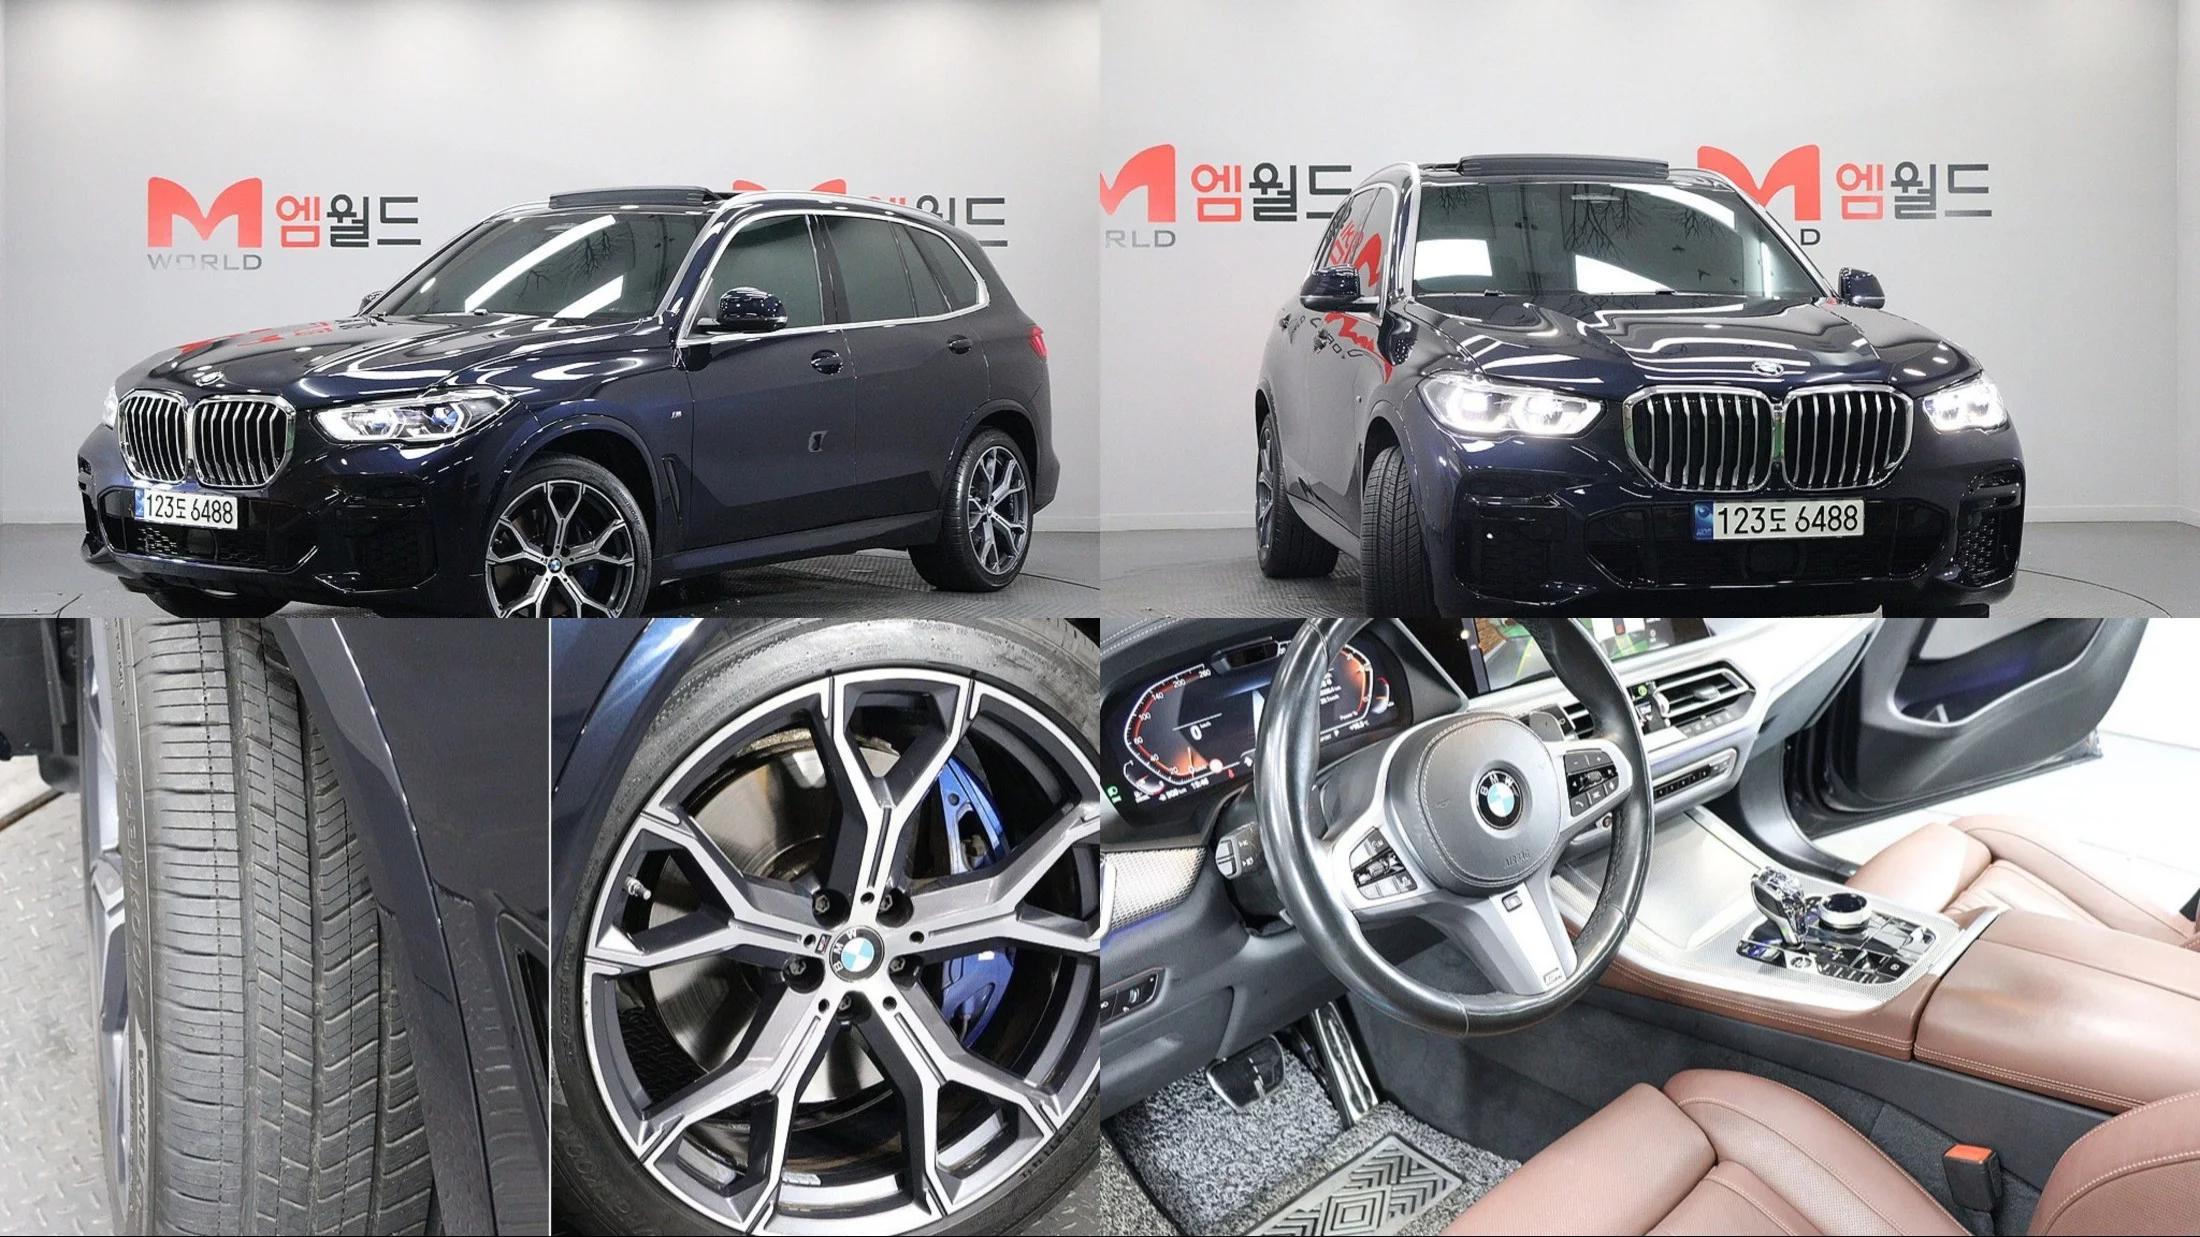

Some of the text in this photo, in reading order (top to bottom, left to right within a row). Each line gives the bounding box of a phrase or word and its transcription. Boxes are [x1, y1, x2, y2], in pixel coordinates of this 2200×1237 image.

[1191, 162, 1352, 222] 엠월드
[1836, 161, 1992, 220] 엠월드
[147, 177, 263, 248] M
[276, 193, 421, 250] 엠월드
[1105, 230, 1176, 248] RLD
[147, 254, 262, 271] WORLD
[147, 494, 233, 524] 123도 6488
[1718, 505, 1858, 534] 123도 6488
[1152, 692, 1164, 701] 140
[1173, 679, 1186, 688] 200
[1139, 712, 1151, 721] 100
[1480, 771, 1514, 796] BMW
[833, 928, 857, 973] BMW
